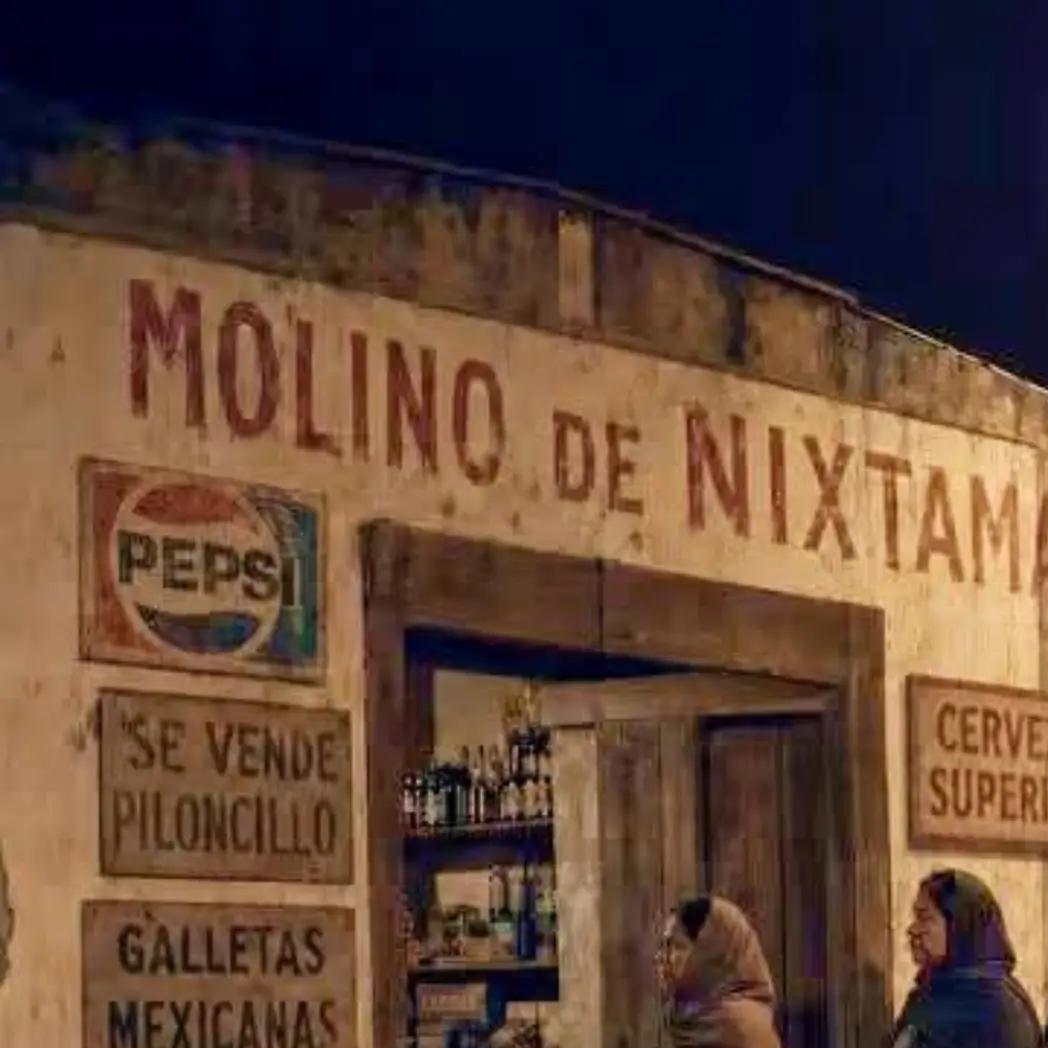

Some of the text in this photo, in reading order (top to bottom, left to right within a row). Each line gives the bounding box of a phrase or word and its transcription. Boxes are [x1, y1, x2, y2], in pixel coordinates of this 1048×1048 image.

[129, 278, 505, 486] MOLINO
[553, 409, 643, 515] DE
[117, 530, 295, 606] PEPSI
[128, 717, 338, 781] SE VENDE
[114, 789, 336, 857] PILONCILLO
[117, 923, 325, 976] GALLETAS
